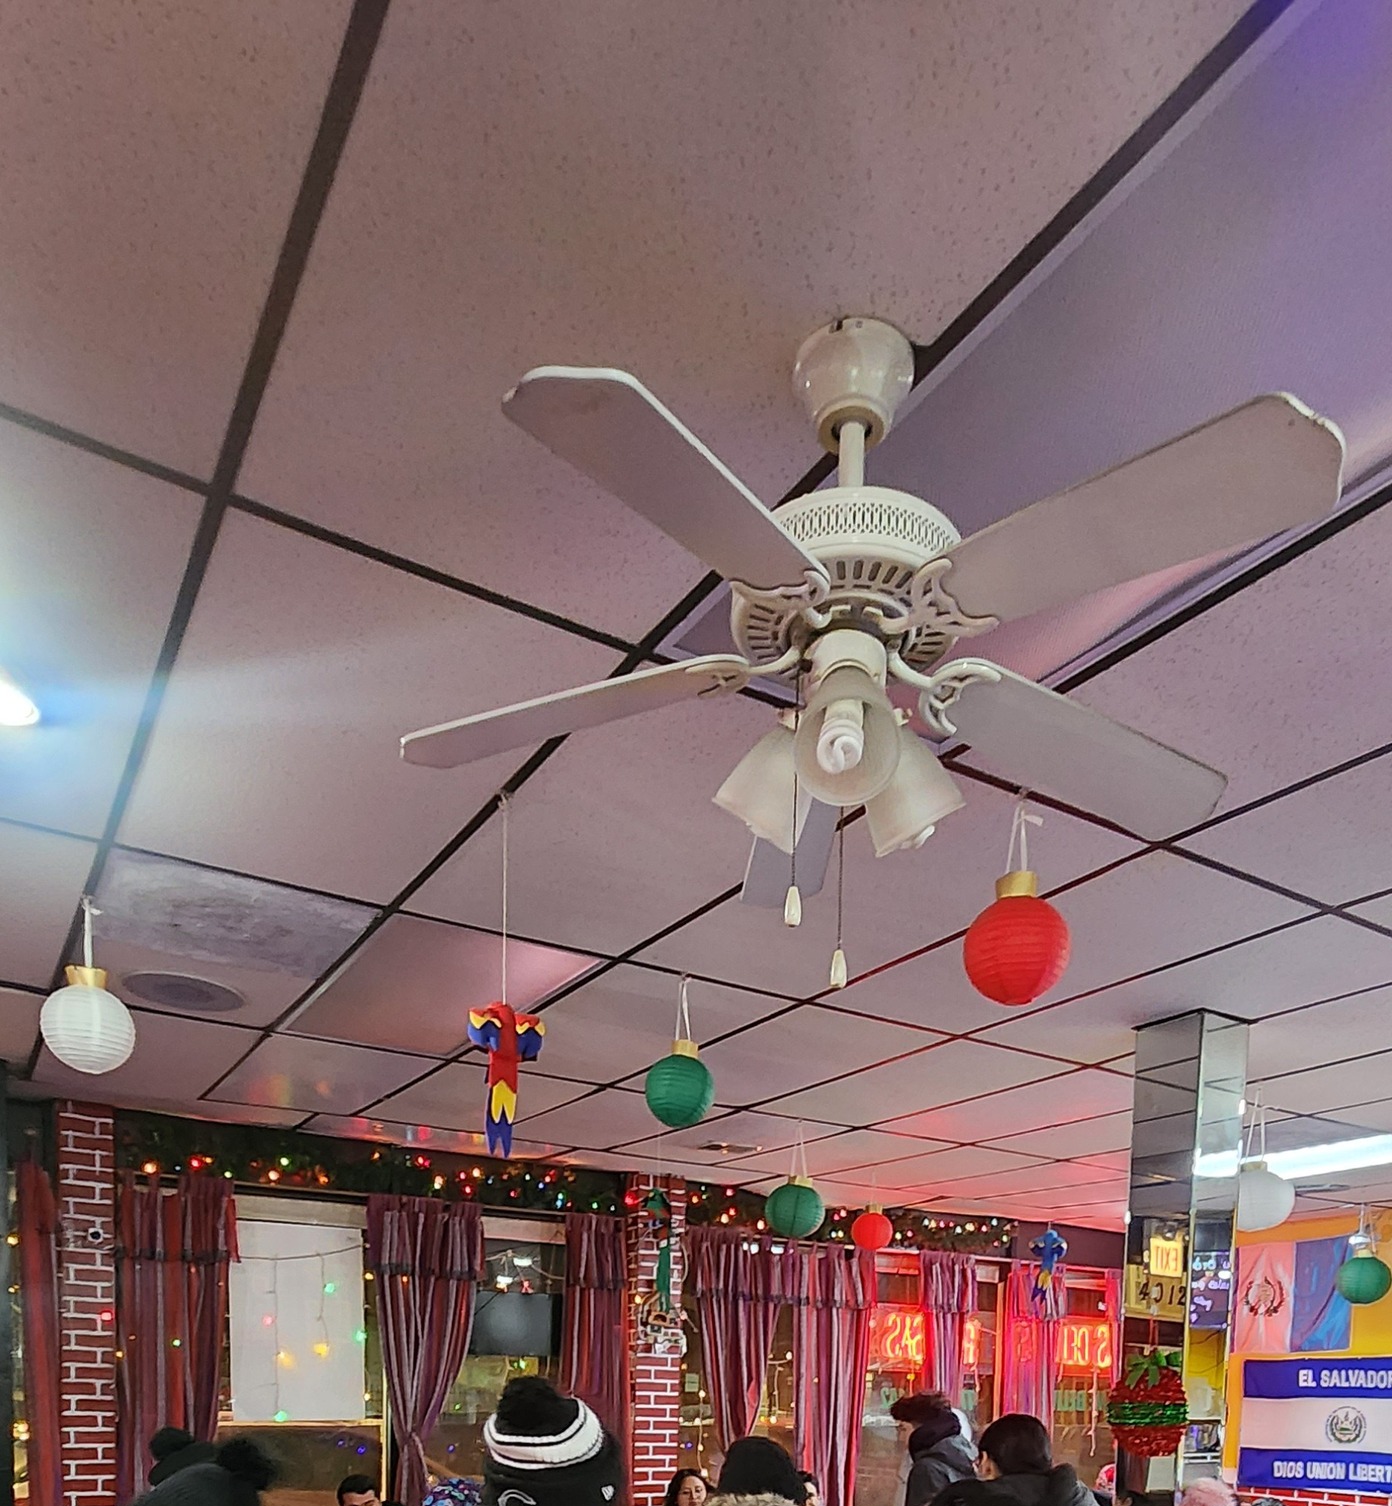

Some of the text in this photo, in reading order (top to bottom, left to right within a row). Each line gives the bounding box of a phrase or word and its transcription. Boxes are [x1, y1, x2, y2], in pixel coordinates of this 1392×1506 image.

[1298, 1369, 1317, 1387] EL
[1273, 1461, 1392, 1483] DIOS UNION LIBERT
